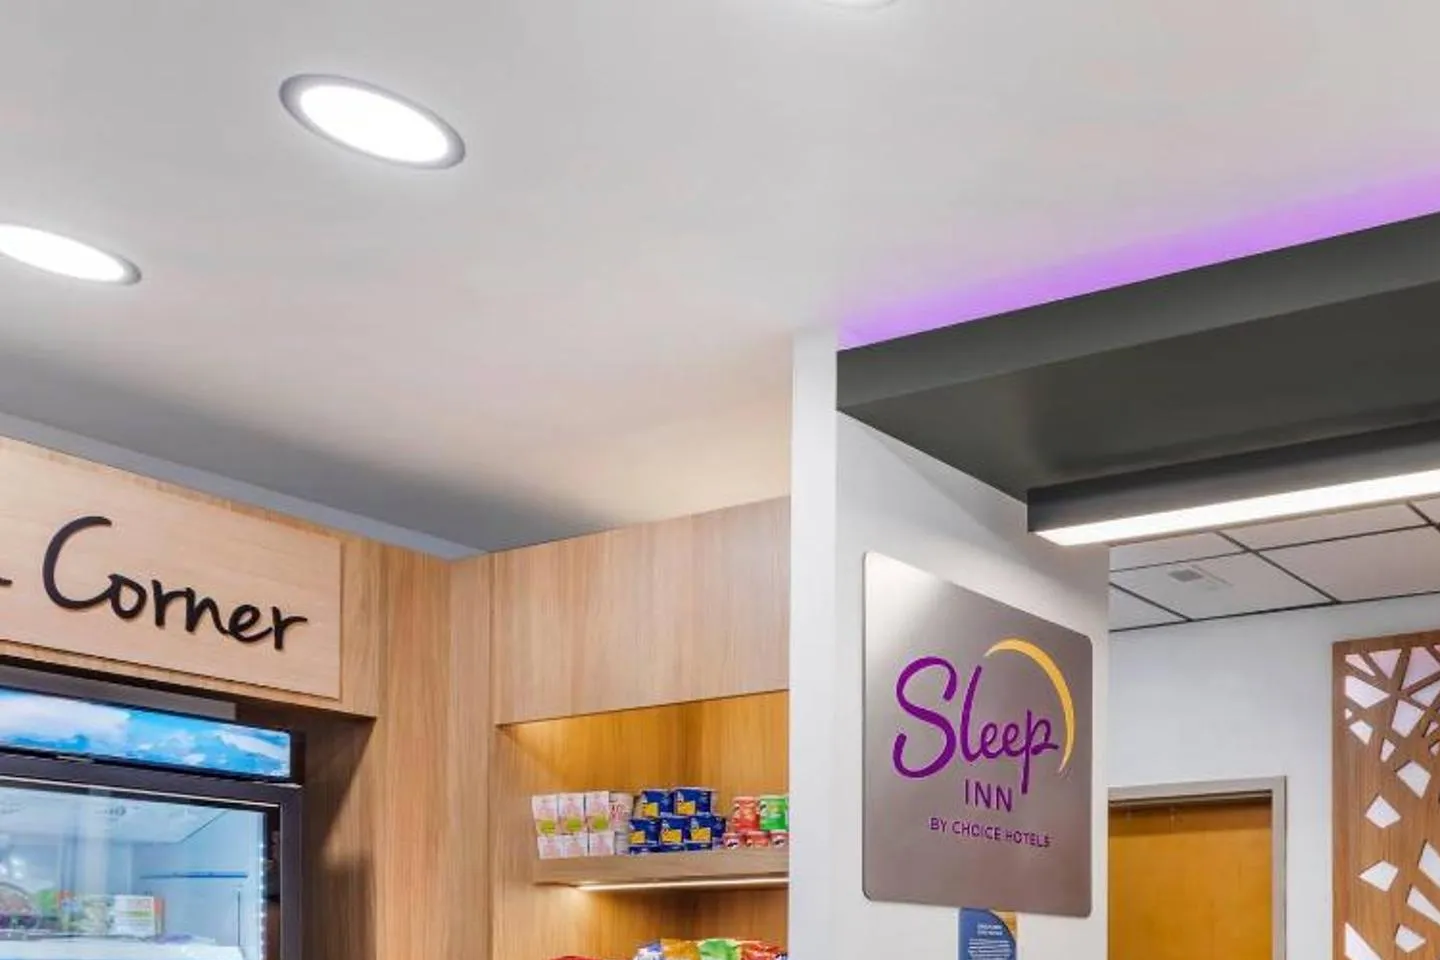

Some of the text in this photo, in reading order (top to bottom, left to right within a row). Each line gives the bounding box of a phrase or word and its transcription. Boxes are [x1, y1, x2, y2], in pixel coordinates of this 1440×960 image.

[42, 515, 308, 650] Corner
[893, 656, 1059, 794] Sleep
[929, 817, 1052, 848] BY CHOICE HOTELS
[964, 778, 1013, 812] INN
